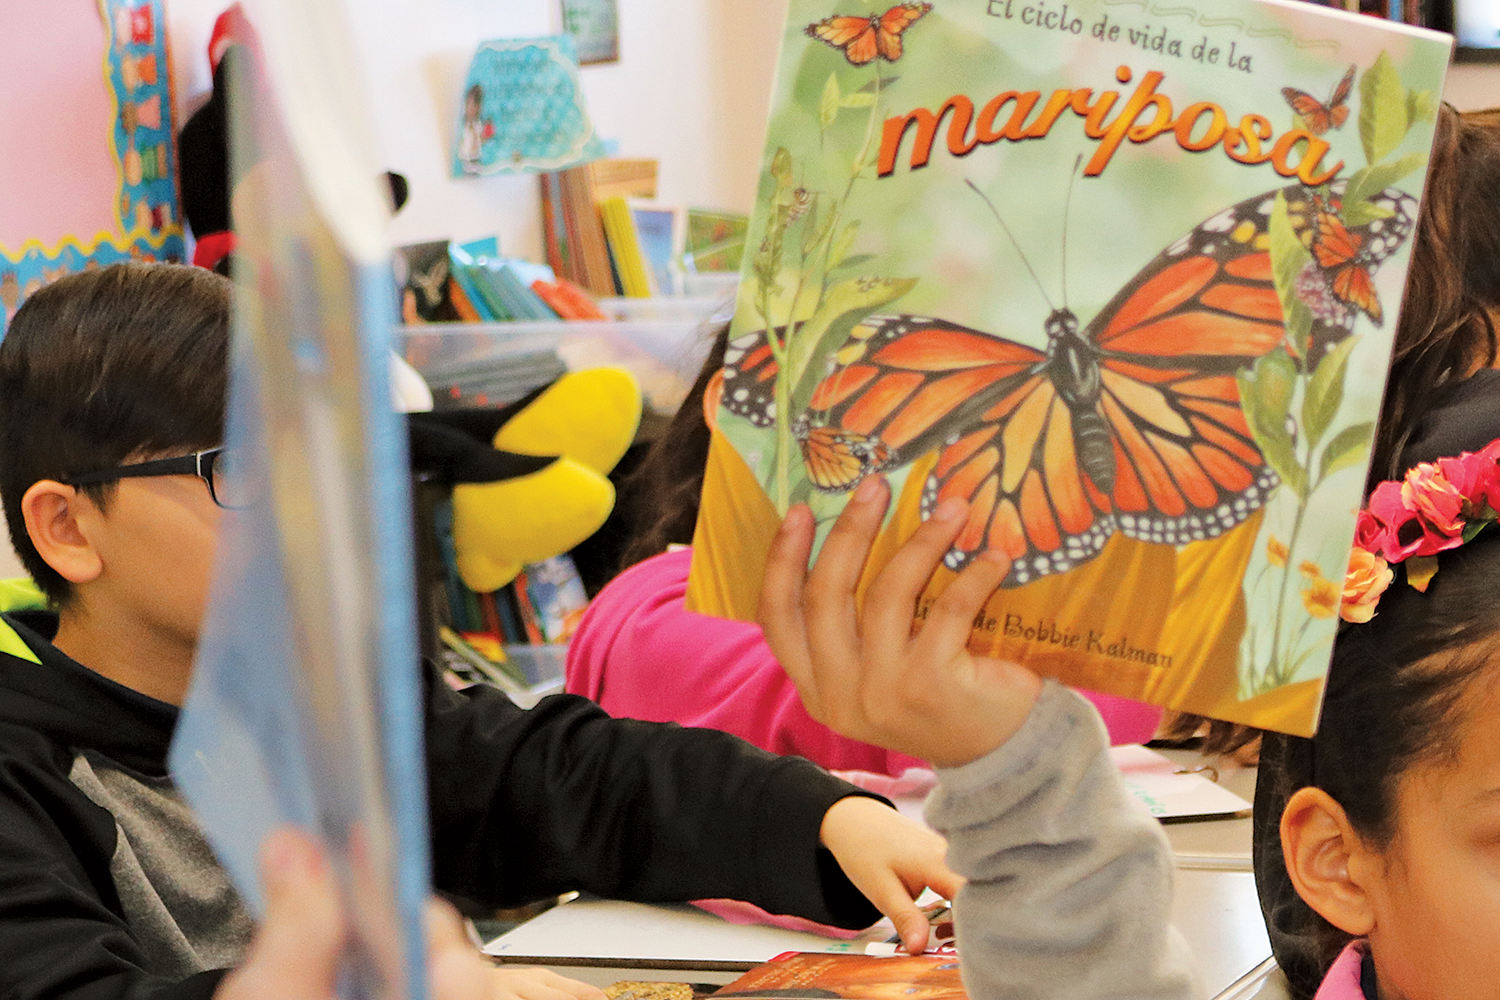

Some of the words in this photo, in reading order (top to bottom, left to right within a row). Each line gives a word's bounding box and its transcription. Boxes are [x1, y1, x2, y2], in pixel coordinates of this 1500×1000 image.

[986, 0, 1013, 20] El
[1021, 4, 1083, 35] ciclo
[1092, 14, 1120, 42] de
[1129, 25, 1182, 58] vida
[1191, 36, 1221, 65] de
[1228, 41, 1254, 74] la
[877, 65, 1346, 187] mariposa
[1003, 613, 1081, 649] Bobbie
[1085, 629, 1173, 669] Kalman
